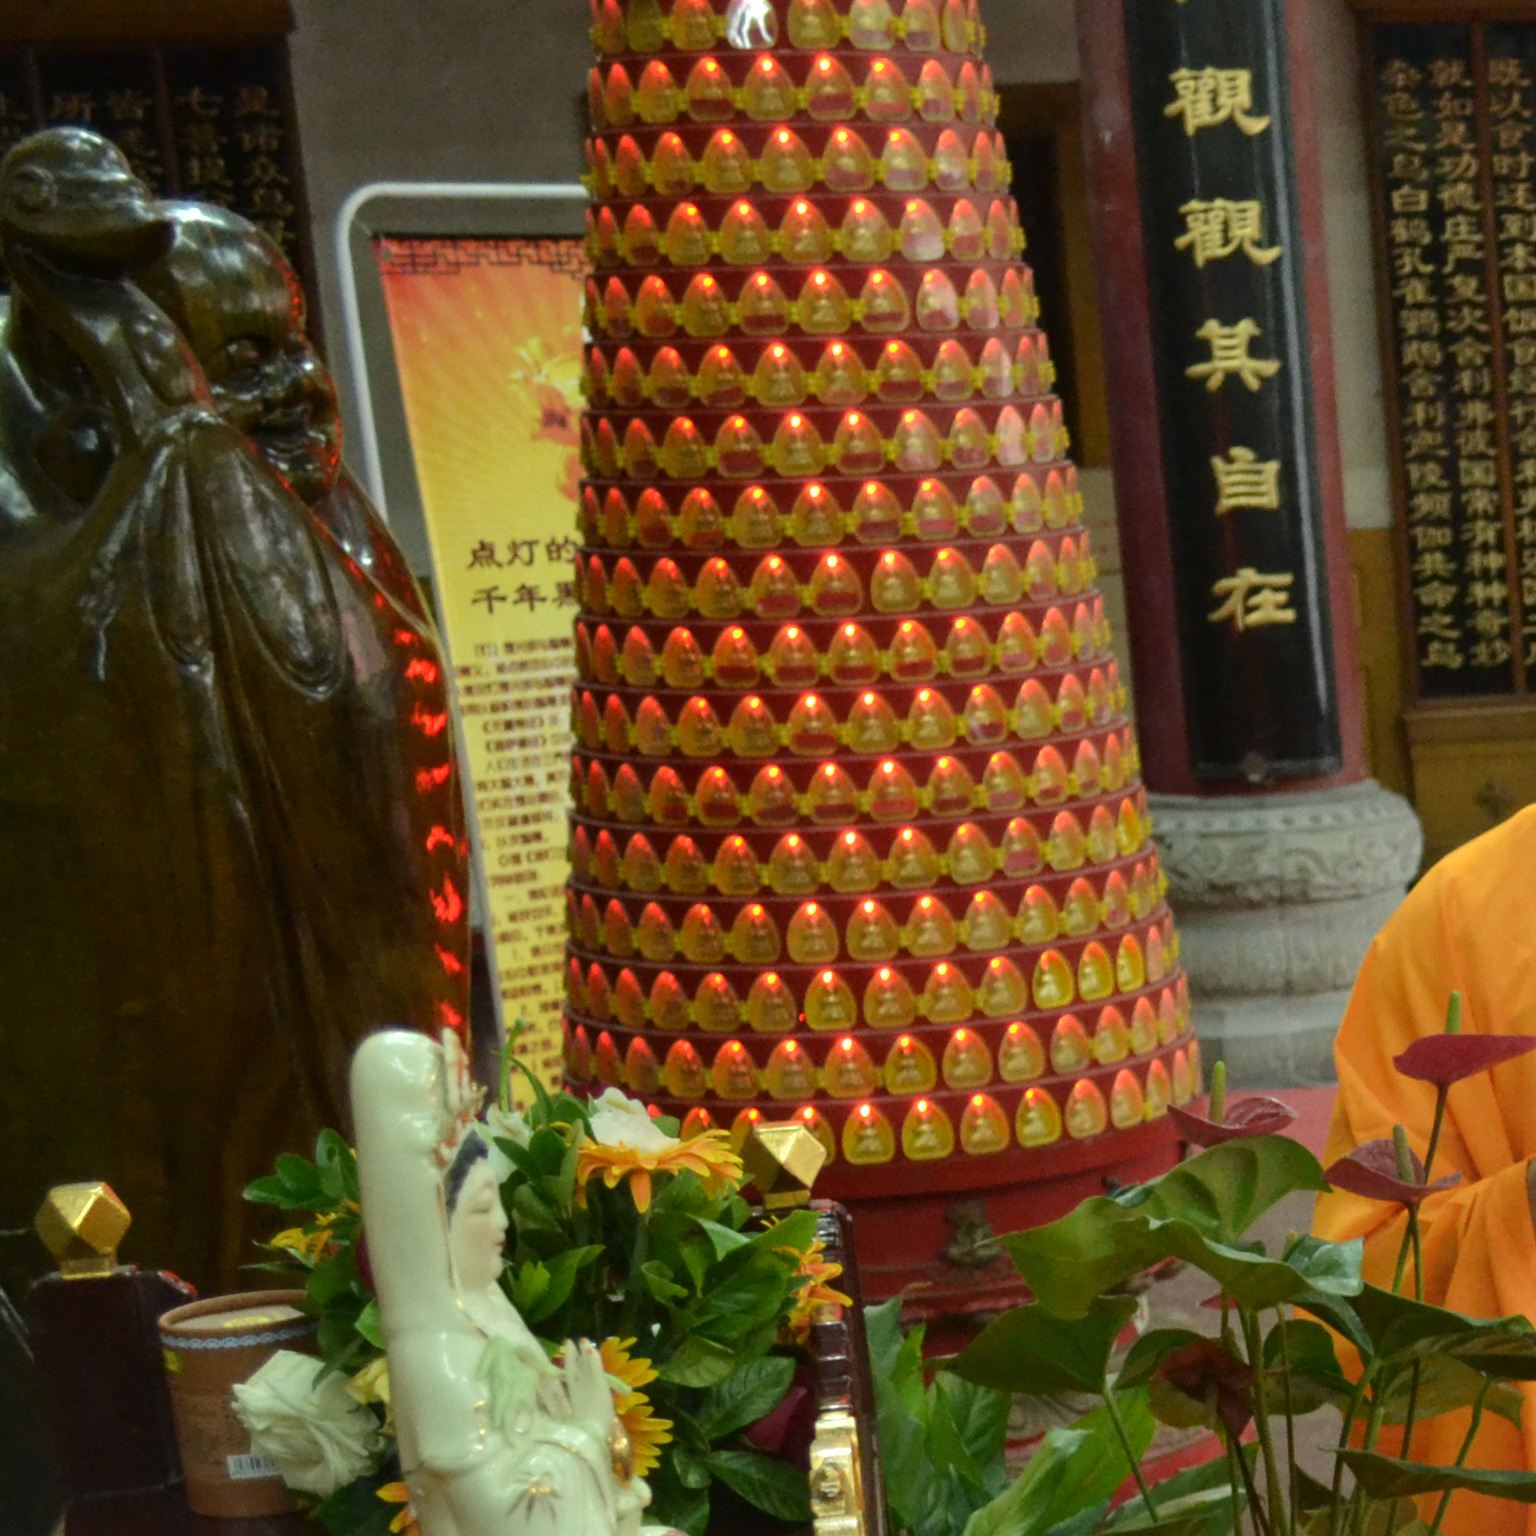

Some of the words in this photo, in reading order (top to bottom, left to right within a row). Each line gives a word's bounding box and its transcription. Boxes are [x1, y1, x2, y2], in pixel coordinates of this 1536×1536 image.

[1162, 0, 1299, 629] 觀觀其自在
[466, 535, 581, 569] 点灯的
